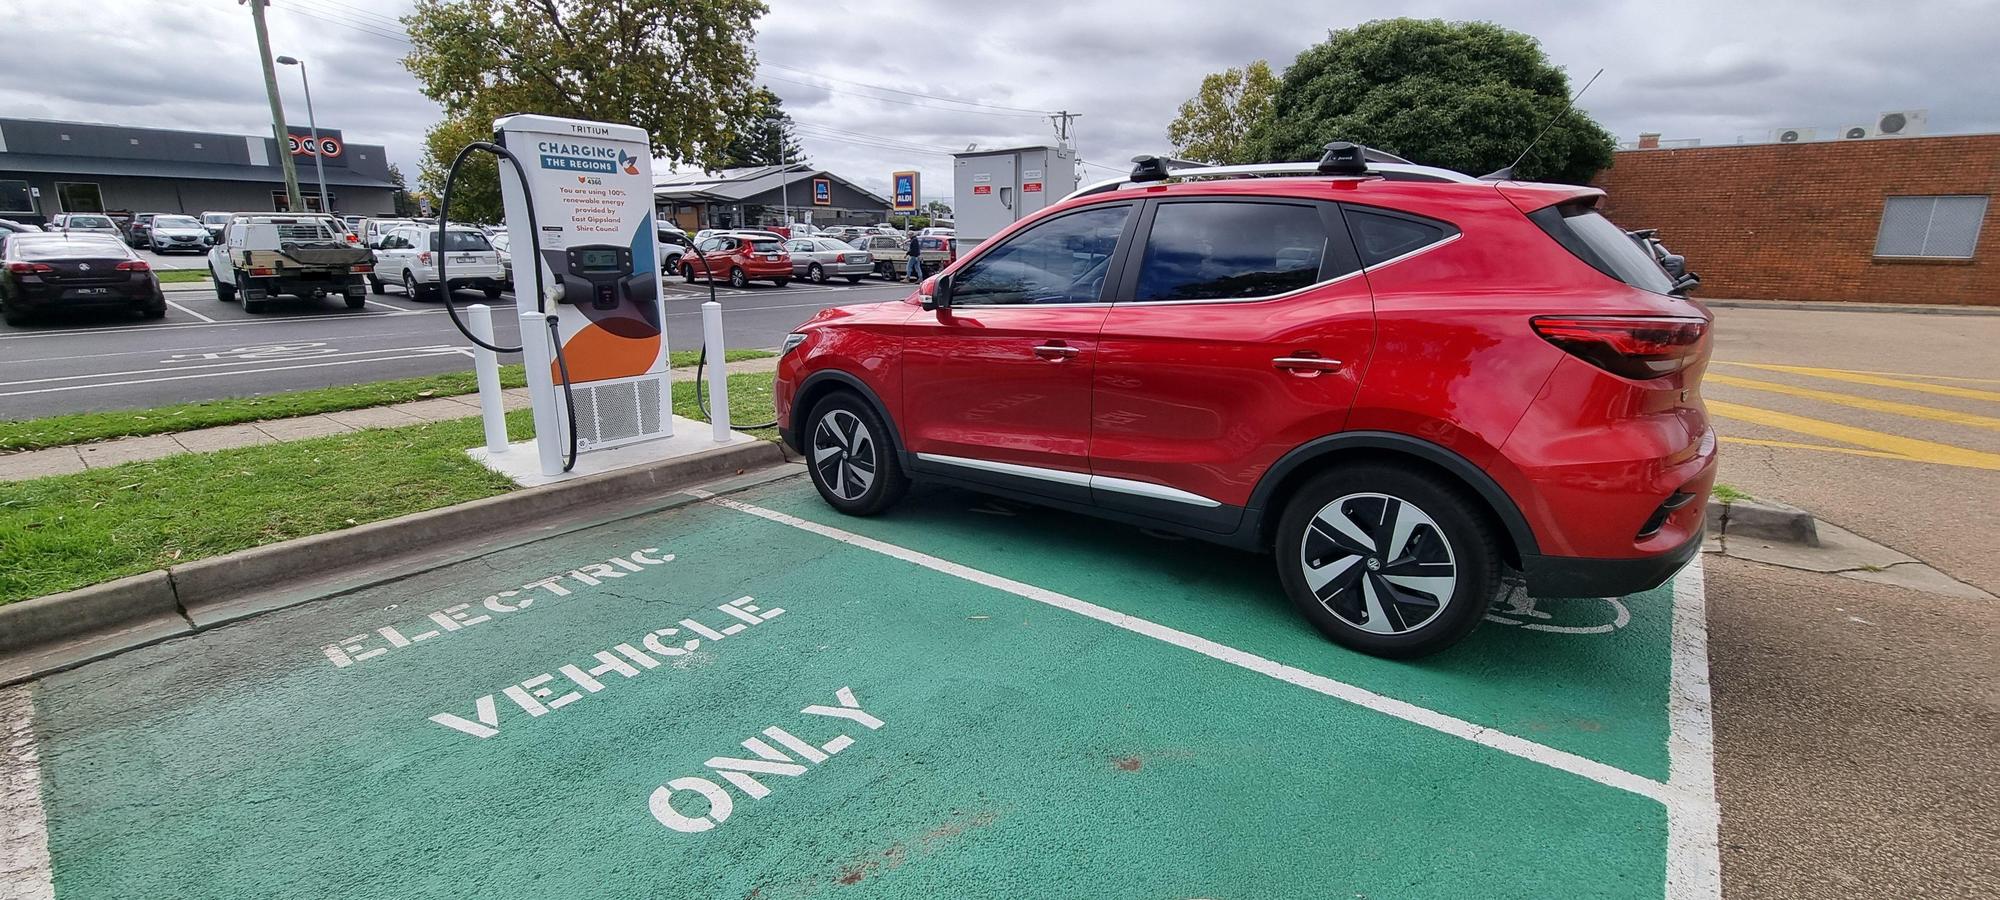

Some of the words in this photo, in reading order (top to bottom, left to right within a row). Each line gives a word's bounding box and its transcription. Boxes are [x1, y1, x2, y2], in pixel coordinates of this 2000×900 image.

[571, 124, 609, 135] TRITIUM
[289, 140, 334, 152] BWS
[538, 142, 616, 158] CHARGING
[546, 158, 567, 167] THE
[570, 159, 611, 170] REGIONS
[897, 194, 912, 202] ALDI
[607, 207, 616, 215] by
[587, 216, 621, 224] Gippsland
[320, 547, 676, 668] ELECTRIC
[428, 595, 786, 738] VEHICLE
[646, 686, 886, 833] ONLY
